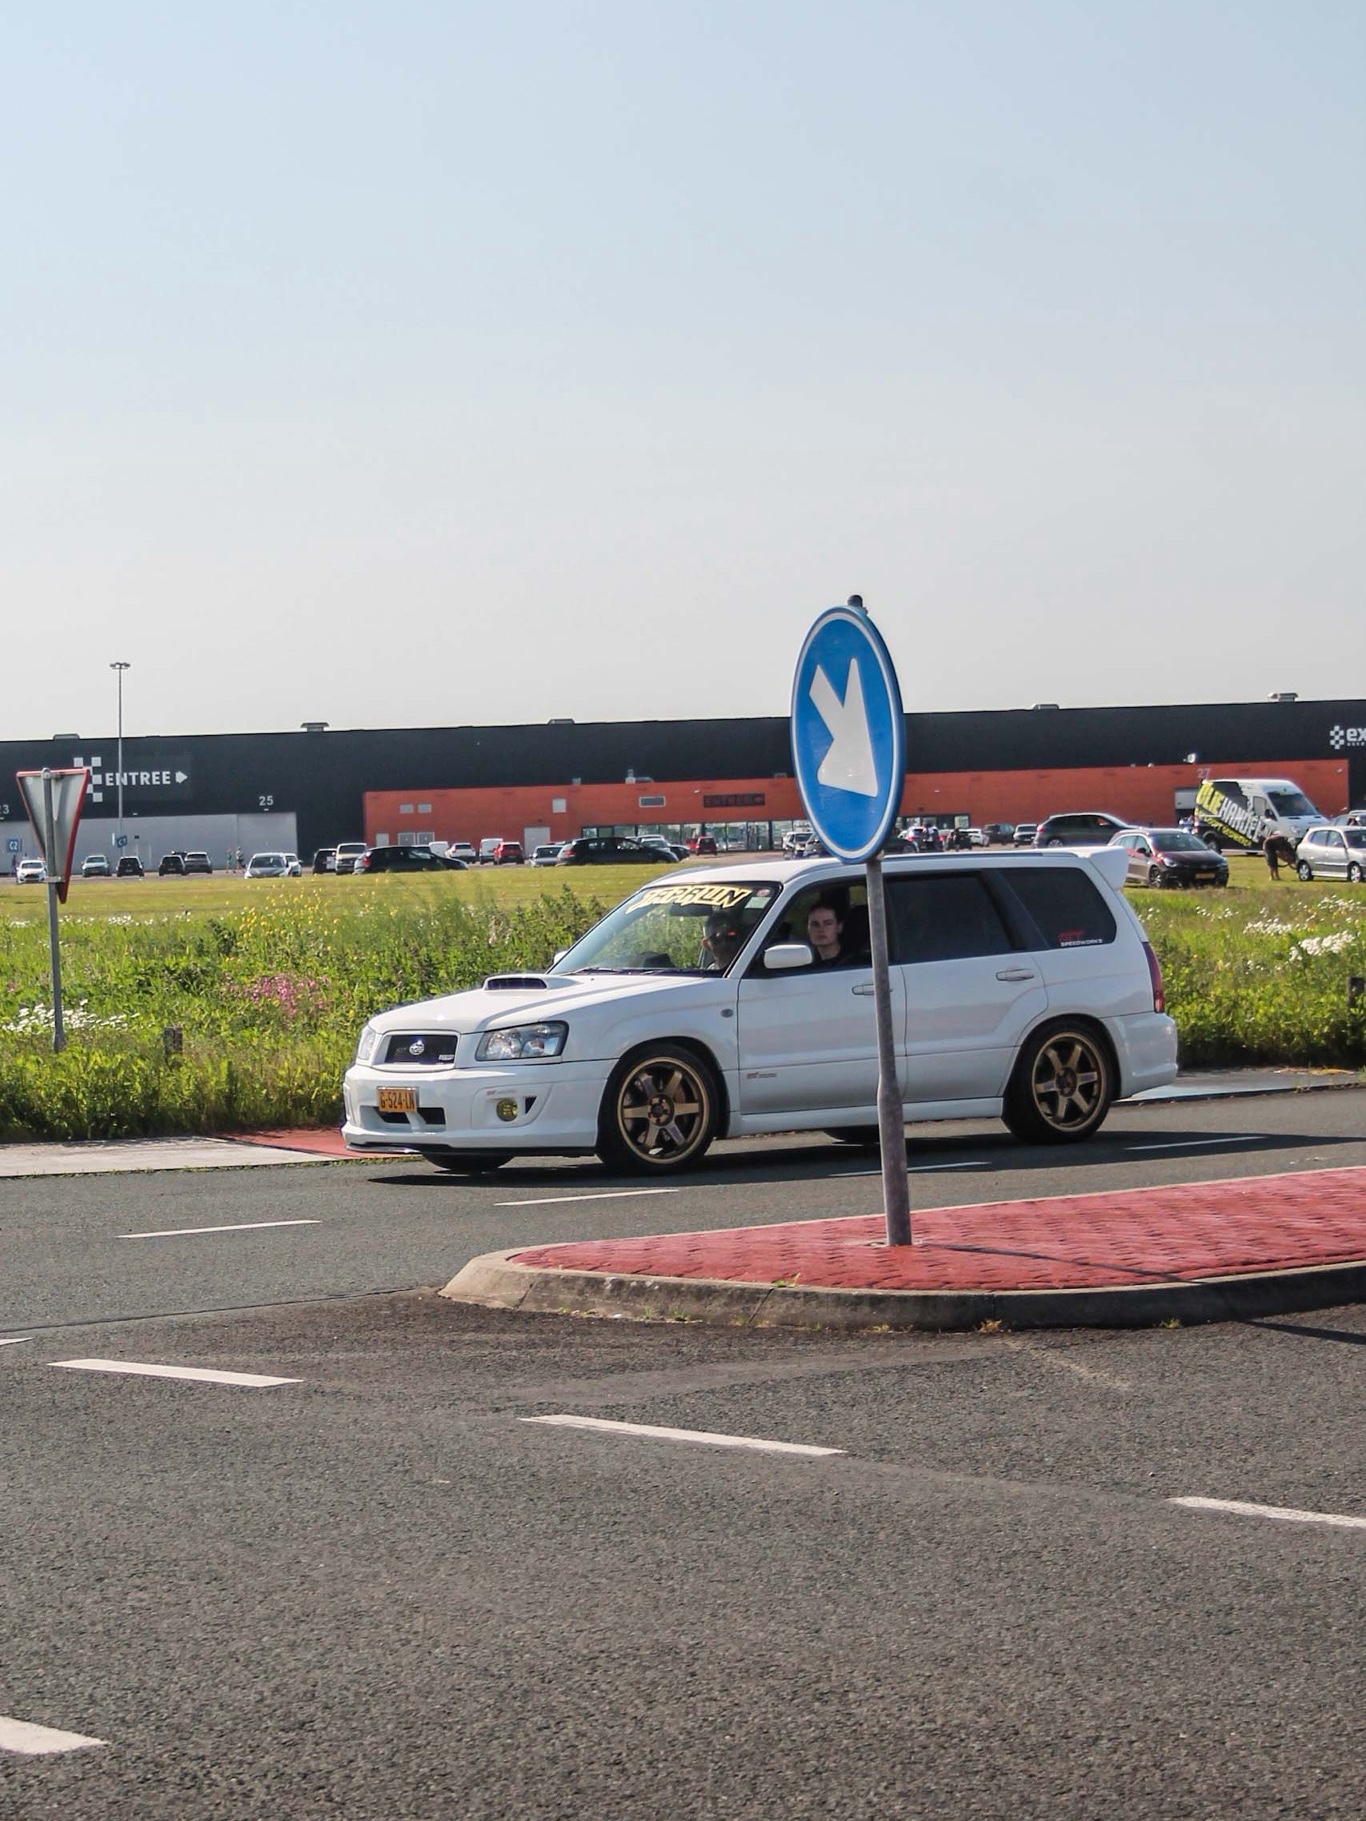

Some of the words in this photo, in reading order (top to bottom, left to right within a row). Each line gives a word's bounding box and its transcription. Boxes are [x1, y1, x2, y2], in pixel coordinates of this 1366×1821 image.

[105, 770, 171, 786] ENTREE
[1197, 768, 1211, 779] 27
[259, 795, 274, 806] 25
[0, 804, 9, 814] 3
